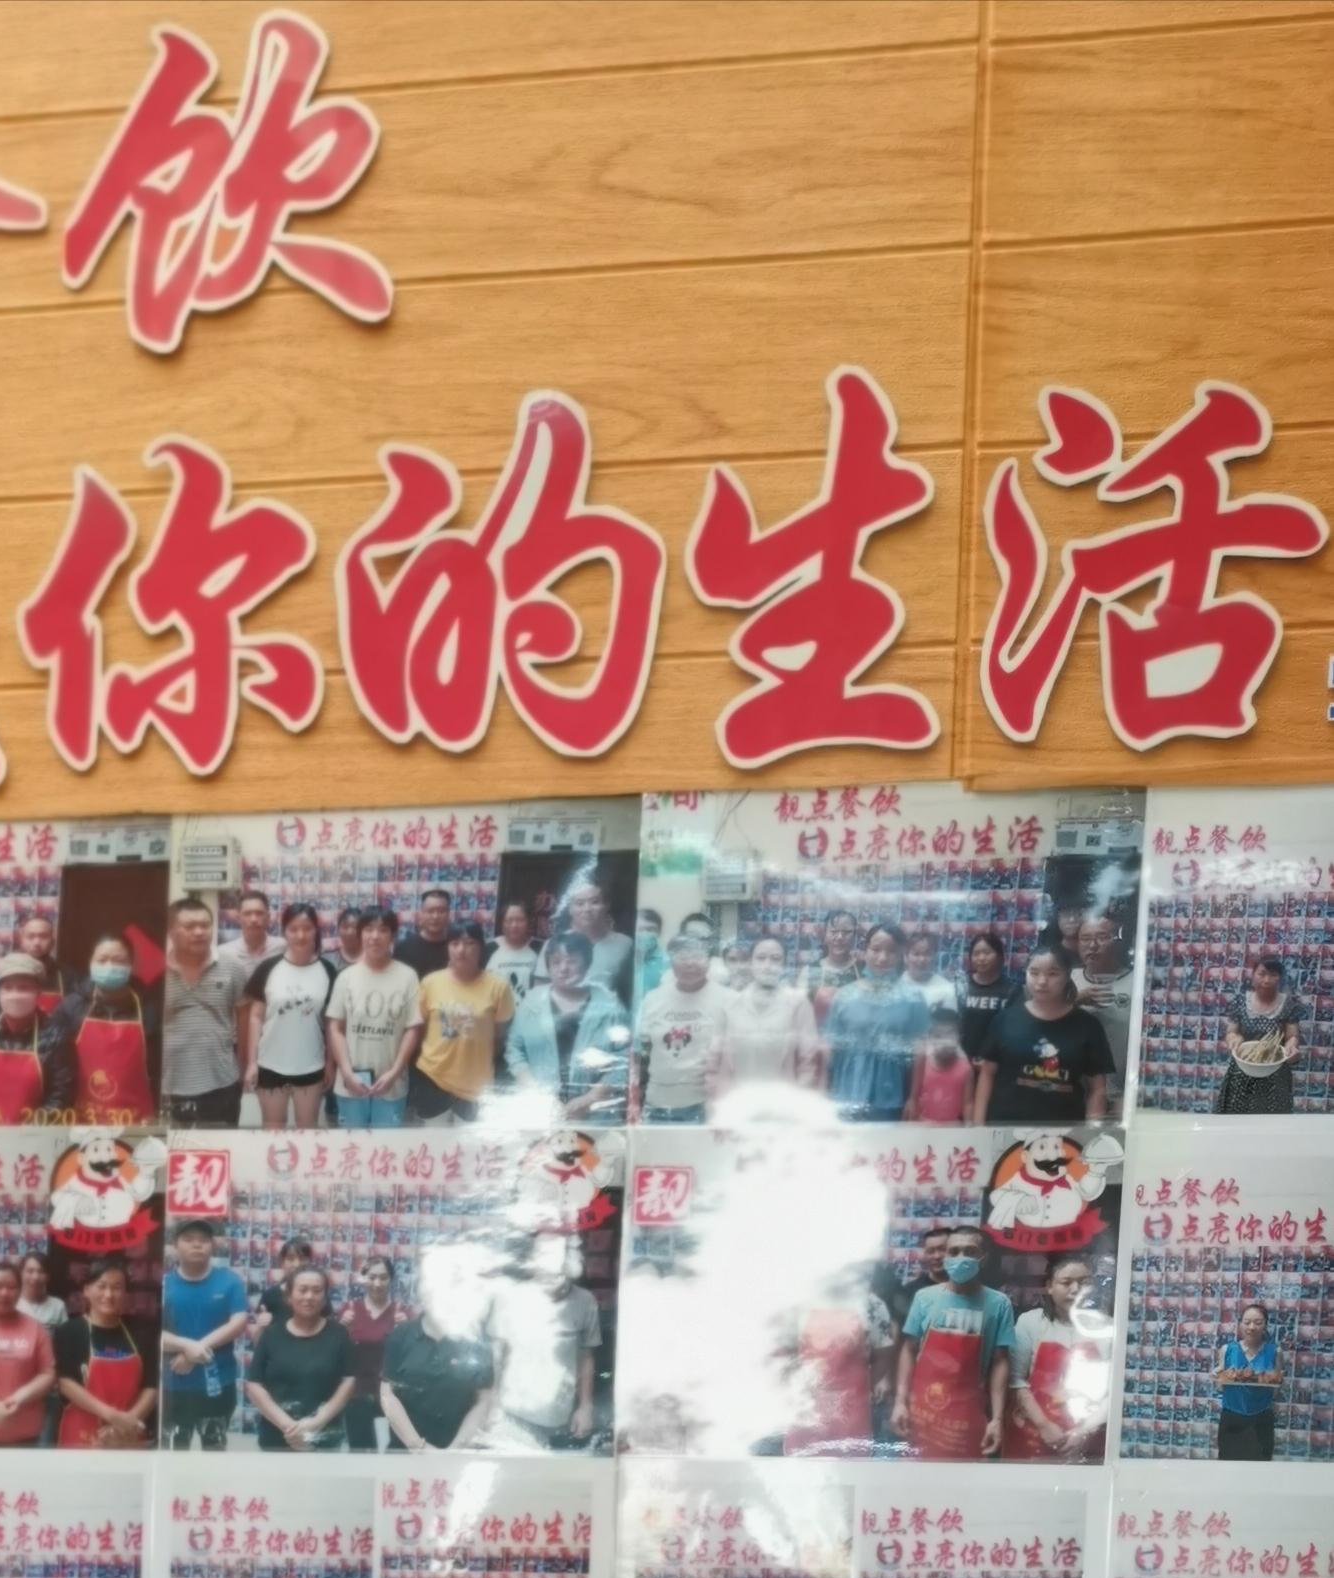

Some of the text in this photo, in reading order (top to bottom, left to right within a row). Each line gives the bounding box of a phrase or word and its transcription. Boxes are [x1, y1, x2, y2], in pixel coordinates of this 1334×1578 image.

[774, 784, 902, 823] 靓点餐饮
[310, 814, 499, 852] 点亮你的生活
[833, 815, 1044, 863] 点亮你的生活
[1153, 825, 1267, 855] 靓点餐饮
[303, 1142, 507, 1182] 点亮你的生活
[1177, 1208, 1327, 1244] 点亮你的生
[217, 1526, 374, 1557] 点亮你的生活
[906, 1537, 1083, 1568] 点亮你的生活
[1168, 1544, 1334, 1578] 点亮你的生
